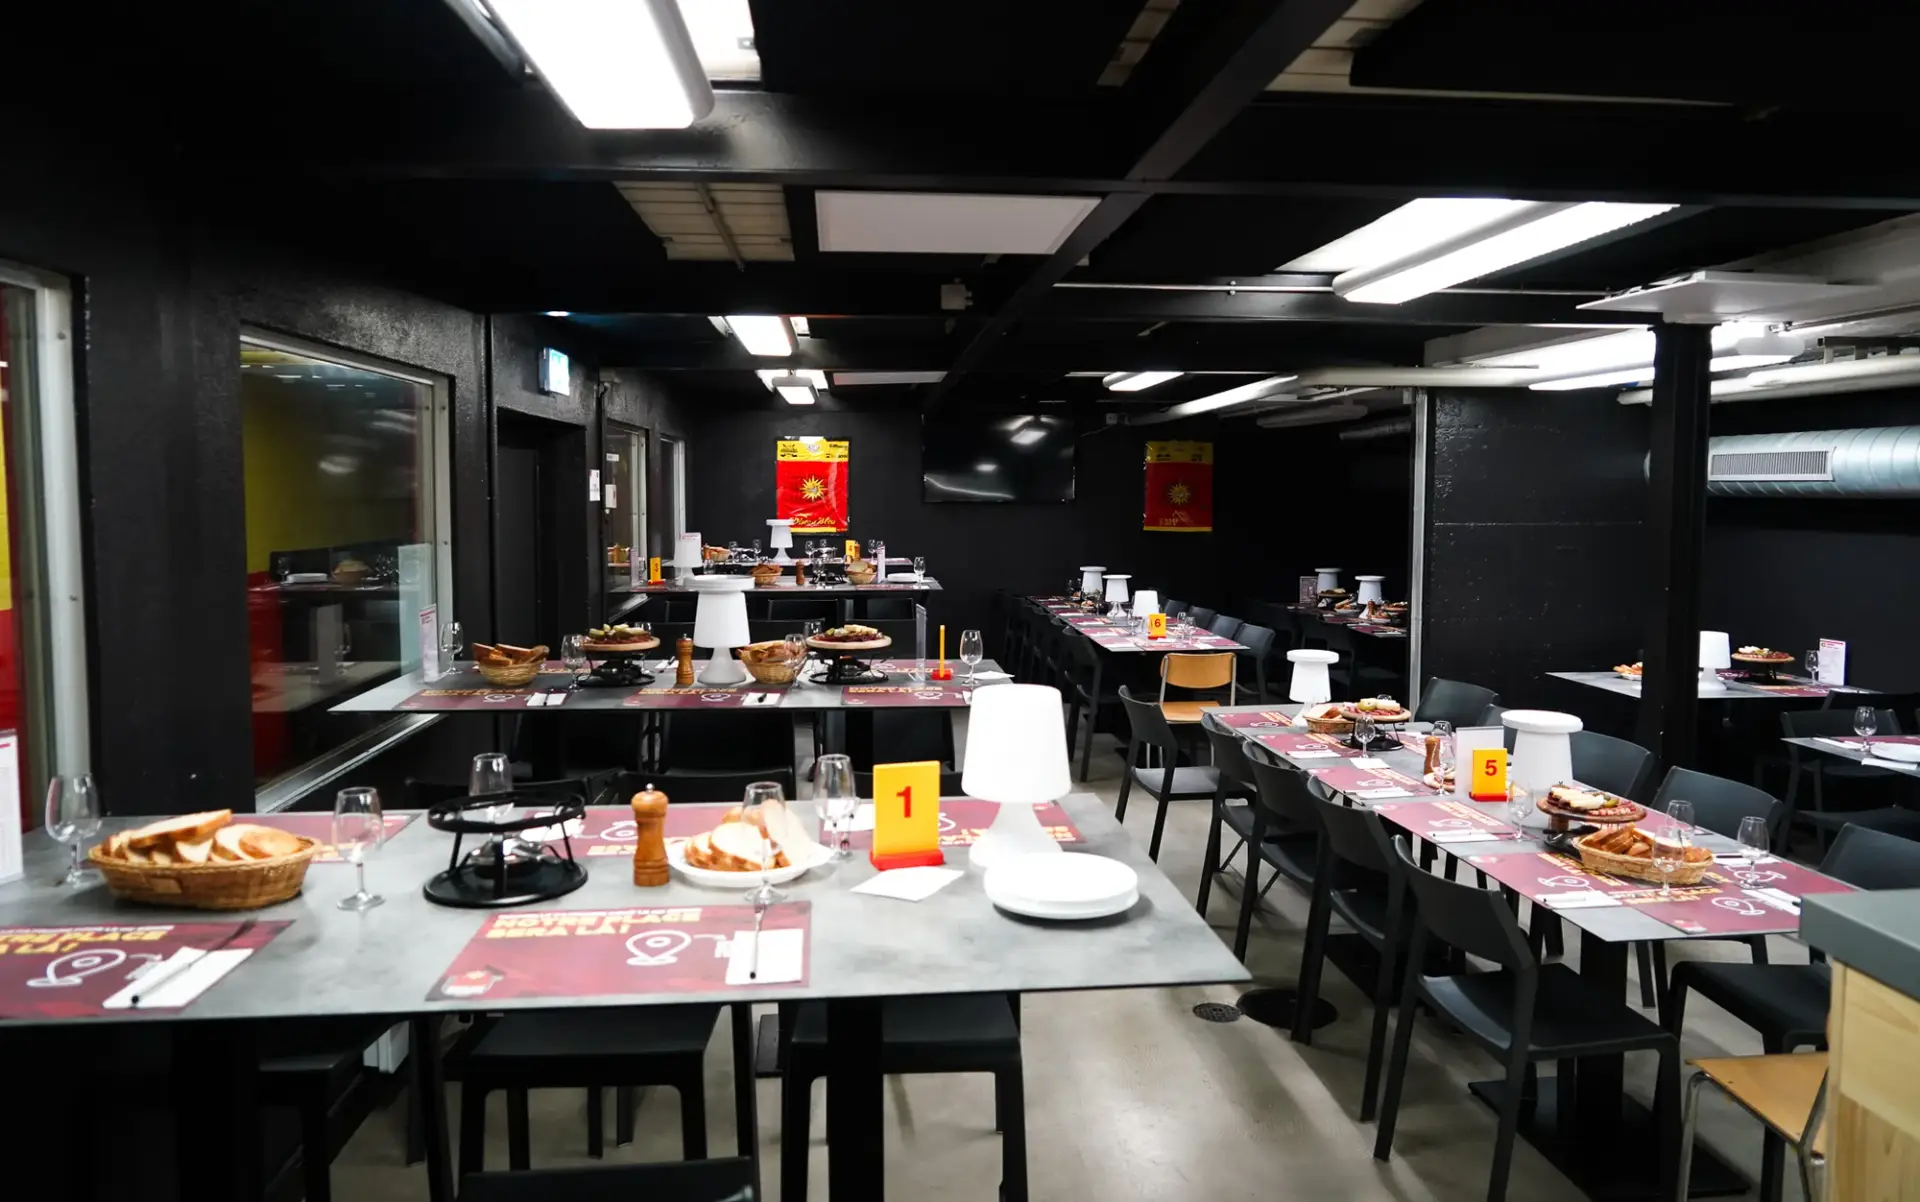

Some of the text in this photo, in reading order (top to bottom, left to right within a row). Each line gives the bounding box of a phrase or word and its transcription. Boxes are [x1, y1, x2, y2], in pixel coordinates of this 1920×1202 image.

[1154, 618, 1161, 627] 6
[1485, 759, 1498, 776] 5
[896, 786, 912, 818] 1
